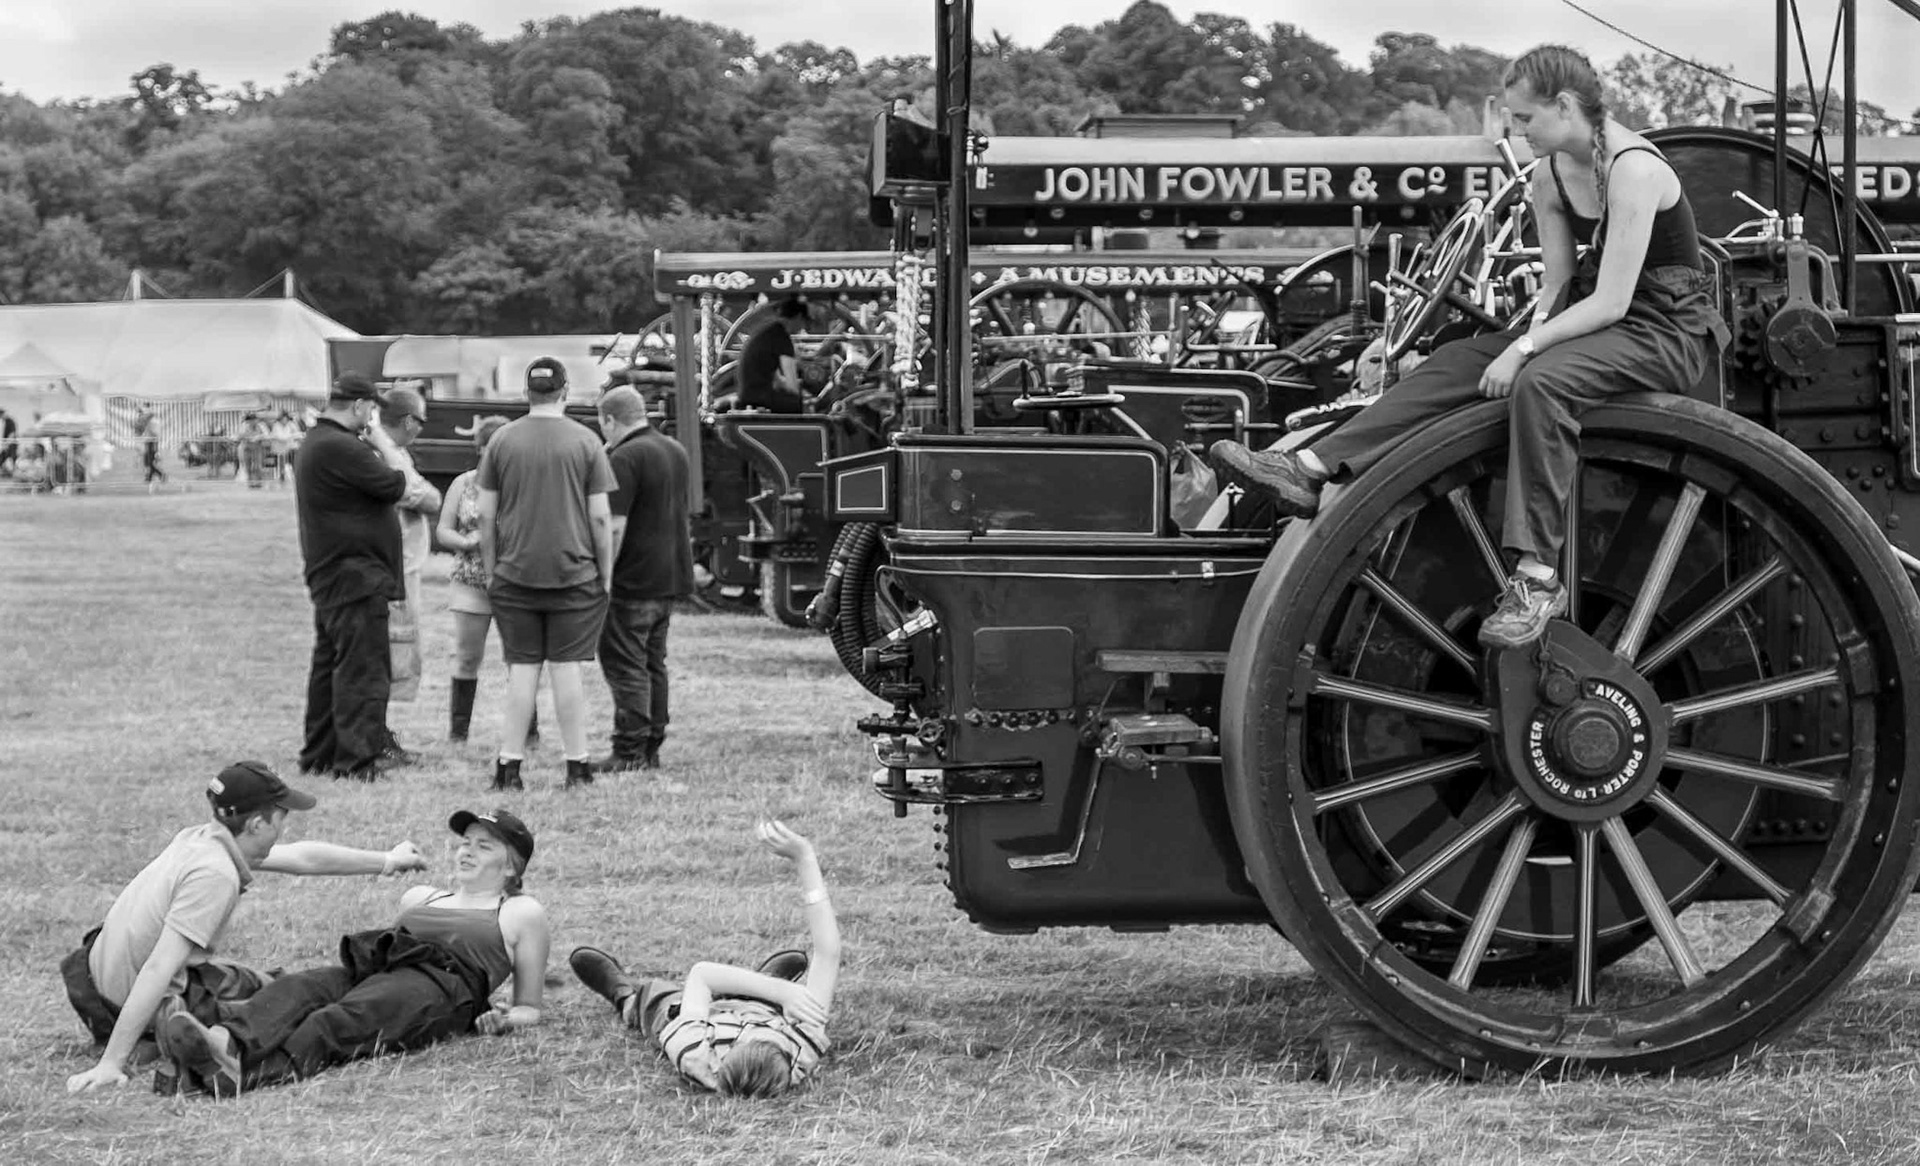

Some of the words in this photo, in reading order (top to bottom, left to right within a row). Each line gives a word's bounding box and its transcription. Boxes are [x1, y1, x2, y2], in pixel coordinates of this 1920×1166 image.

[1034, 166, 1145, 202] JOHN
[1157, 166, 1334, 201] FOWLER
[1349, 166, 1378, 200] &
[1595, 683, 1642, 728] AVELING
[1529, 721, 1571, 795] ROCHESTER
[1632, 733, 1645, 743] &
[1603, 749, 1643, 795] PORTER
